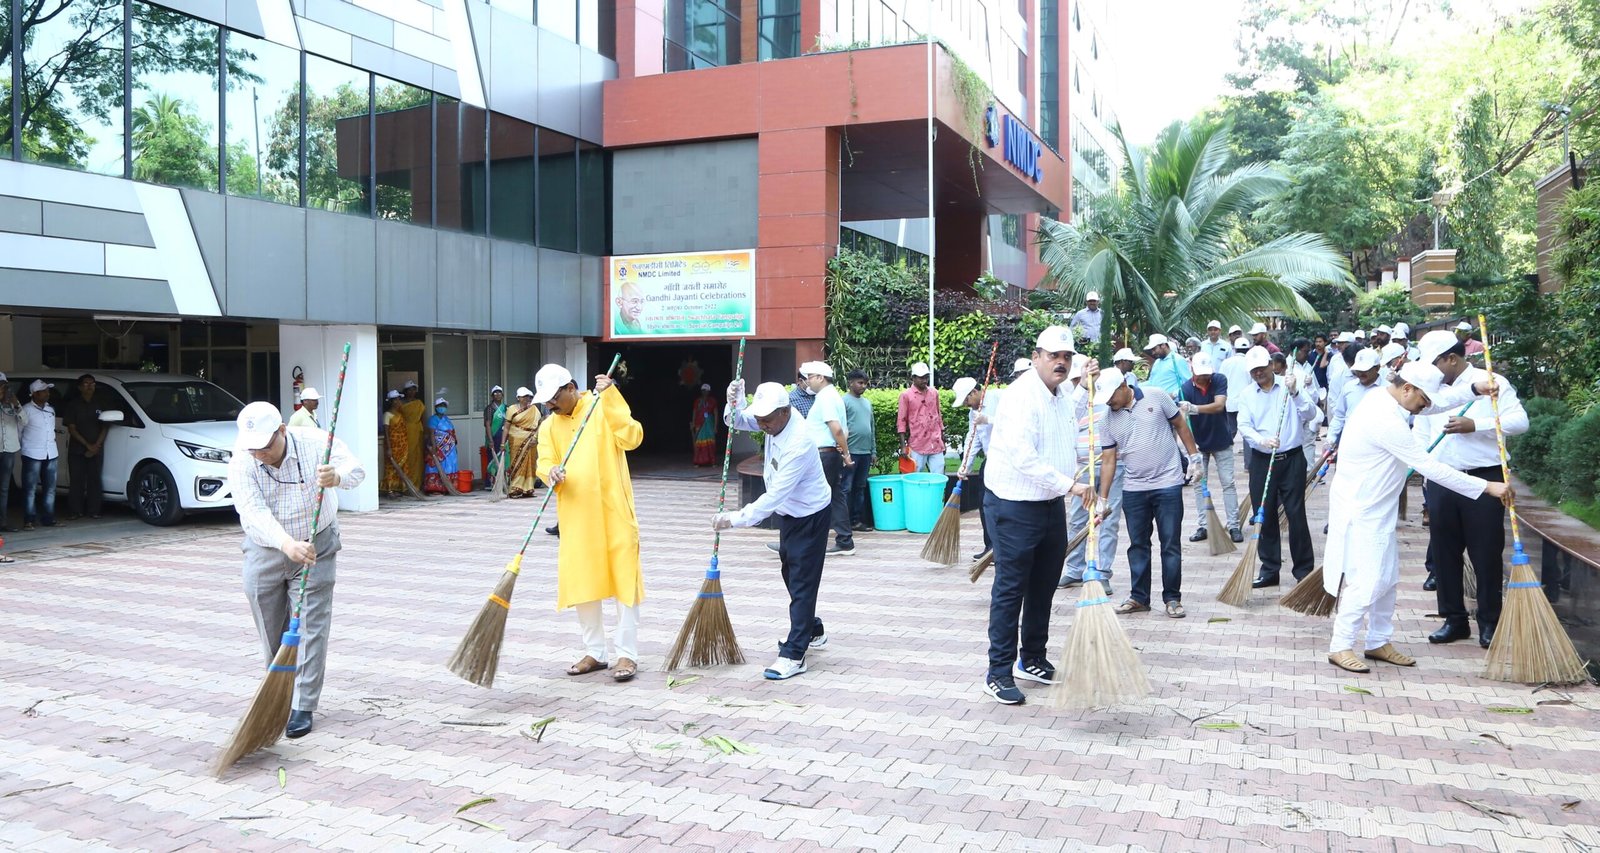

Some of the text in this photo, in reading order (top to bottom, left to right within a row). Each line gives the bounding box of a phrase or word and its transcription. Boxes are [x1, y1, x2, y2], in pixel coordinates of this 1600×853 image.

[1003, 114, 1043, 183] NMDC
[638, 270, 656, 278] NMDC
[658, 270, 681, 278] Limited
[645, 290, 747, 303] Gandhi Jayanti Celebrations
